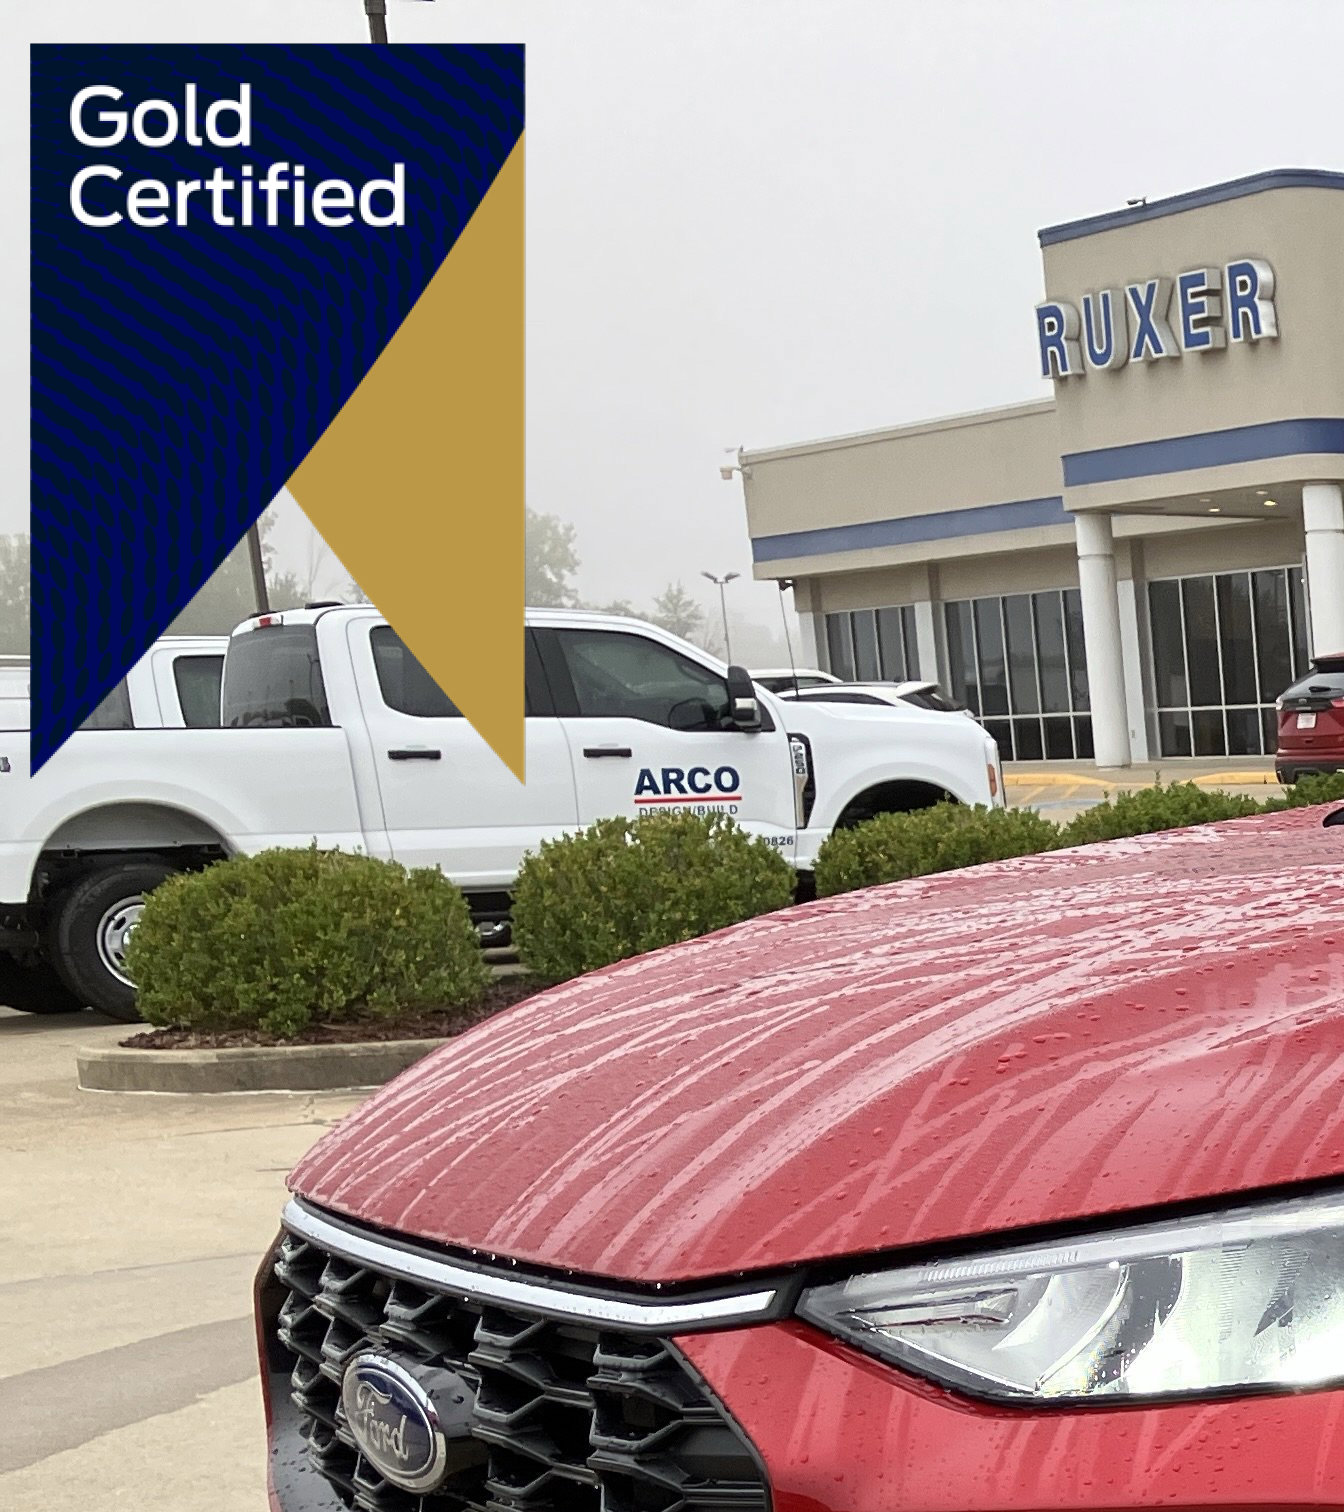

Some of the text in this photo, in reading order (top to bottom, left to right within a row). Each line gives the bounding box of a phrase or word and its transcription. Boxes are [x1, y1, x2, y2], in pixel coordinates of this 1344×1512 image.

[1034, 258, 1278, 379] RUXER
[633, 764, 741, 796] ARCO
[354, 1380, 410, 1461] Ford
